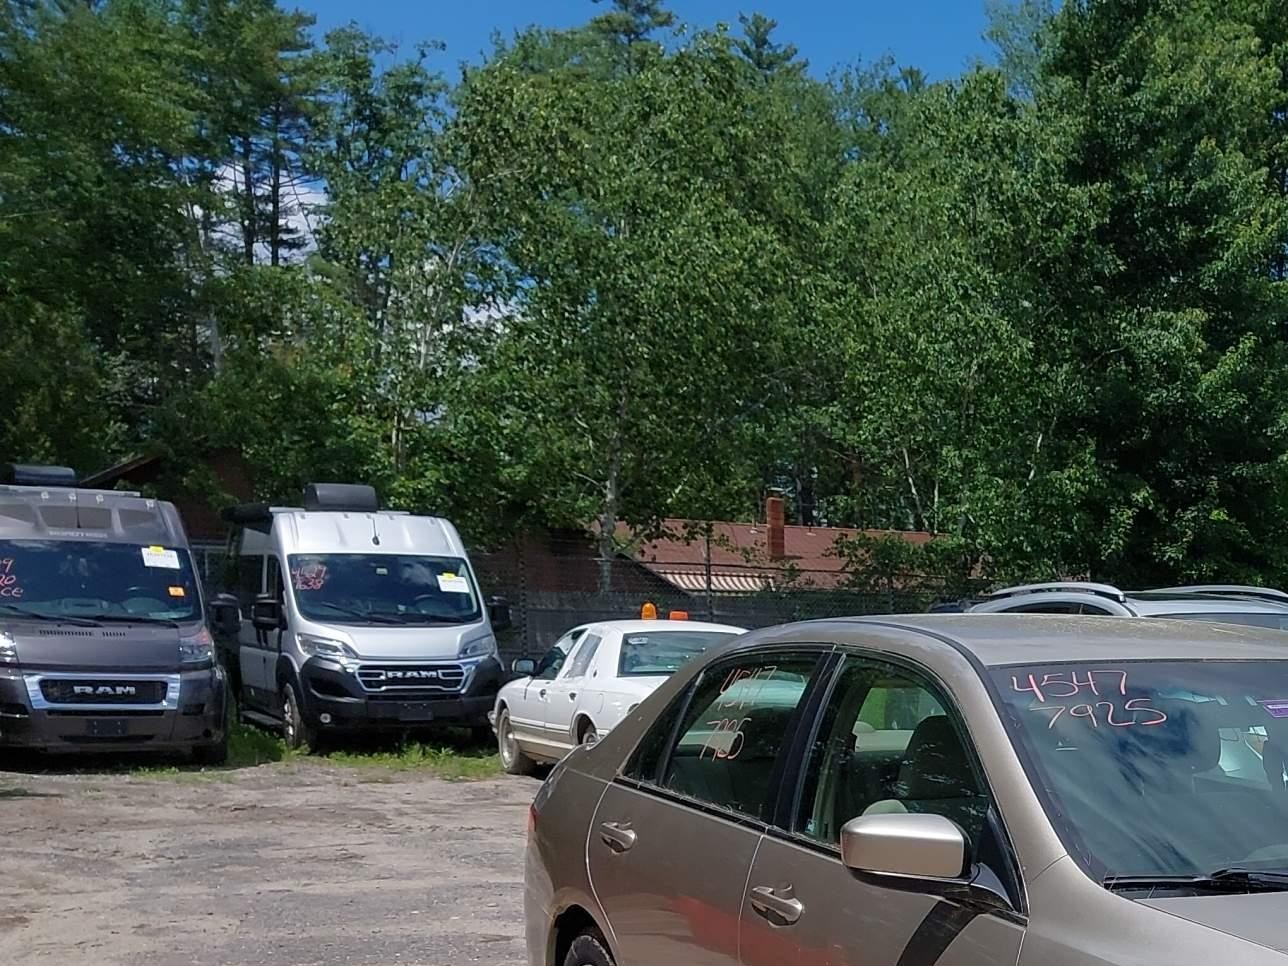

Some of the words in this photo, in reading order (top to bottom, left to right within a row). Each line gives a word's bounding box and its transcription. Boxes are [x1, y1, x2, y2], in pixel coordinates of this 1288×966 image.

[387, 670, 437, 678] RAM
[73, 685, 136, 695] RAM
[1011, 671, 1127, 702] 4547
[1029, 698, 1168, 729] 7925
